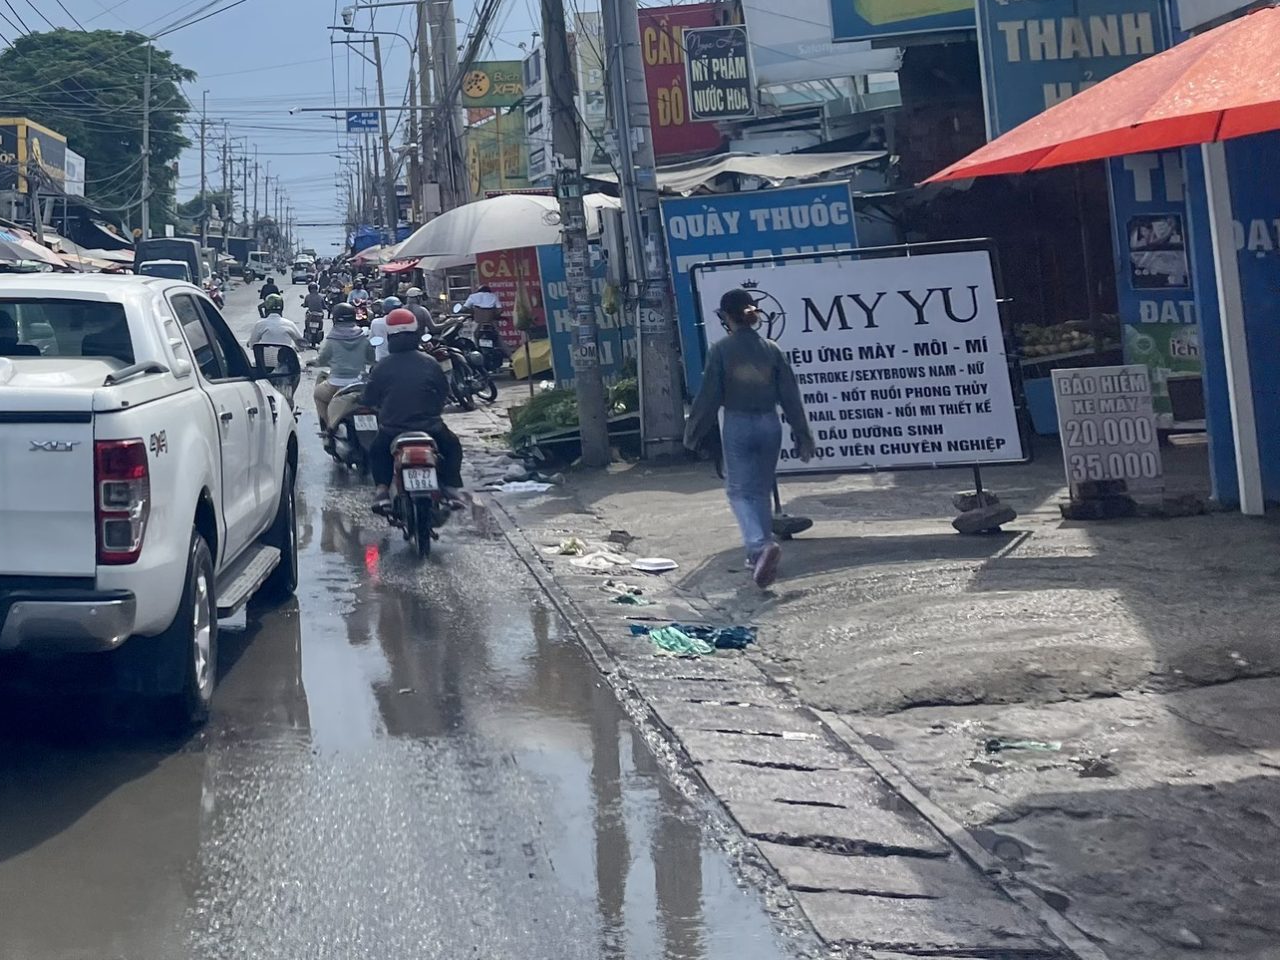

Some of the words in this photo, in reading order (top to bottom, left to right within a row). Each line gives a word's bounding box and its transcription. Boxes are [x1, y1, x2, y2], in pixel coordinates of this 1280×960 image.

[997, 12, 1155, 62] THANH
[691, 54, 709, 82] MỸ
[712, 48, 747, 81] PHẨM
[492, 83, 524, 96] XAN
[657, 74, 684, 127] ĐỒ
[693, 84, 724, 113] NƯỚC
[726, 87, 750, 111] HOA
[670, 204, 741, 241] QUẦY
[749, 194, 849, 232] THUỐC
[801, 291, 887, 333] MY
[897, 285, 979, 326] YU
[818, 344, 853, 363] ỨNG
[859, 343, 896, 361] MÀY
[914, 338, 948, 357] MÔI
[965, 336, 988, 354] MÍ
[929, 364, 956, 378] NAM
[967, 361, 985, 375] NỮ
[803, 389, 829, 404] MÔI
[841, 387, 867, 403] NỐT
[905, 385, 952, 399] PHONG
[954, 380, 988, 396] THỦY
[809, 409, 837, 422] NAIL
[839, 405, 884, 421] DESIGN
[895, 402, 917, 418] NỐI
[920, 402, 936, 417] MI
[938, 399, 972, 415] THIẾT
[975, 398, 992, 414] KẾ
[1071, 399, 1096, 415] XE
[852, 424, 903, 439] DƯỠNG
[907, 423, 944, 436] SINH
[1065, 417, 1153, 448] 20.000
[29, 440, 81, 452] XLT
[839, 442, 875, 458] VIÊN
[880, 439, 943, 456] CHUYÊN
[947, 436, 1006, 453] NGHIỆP
[1070, 451, 1157, 481] 35.000
